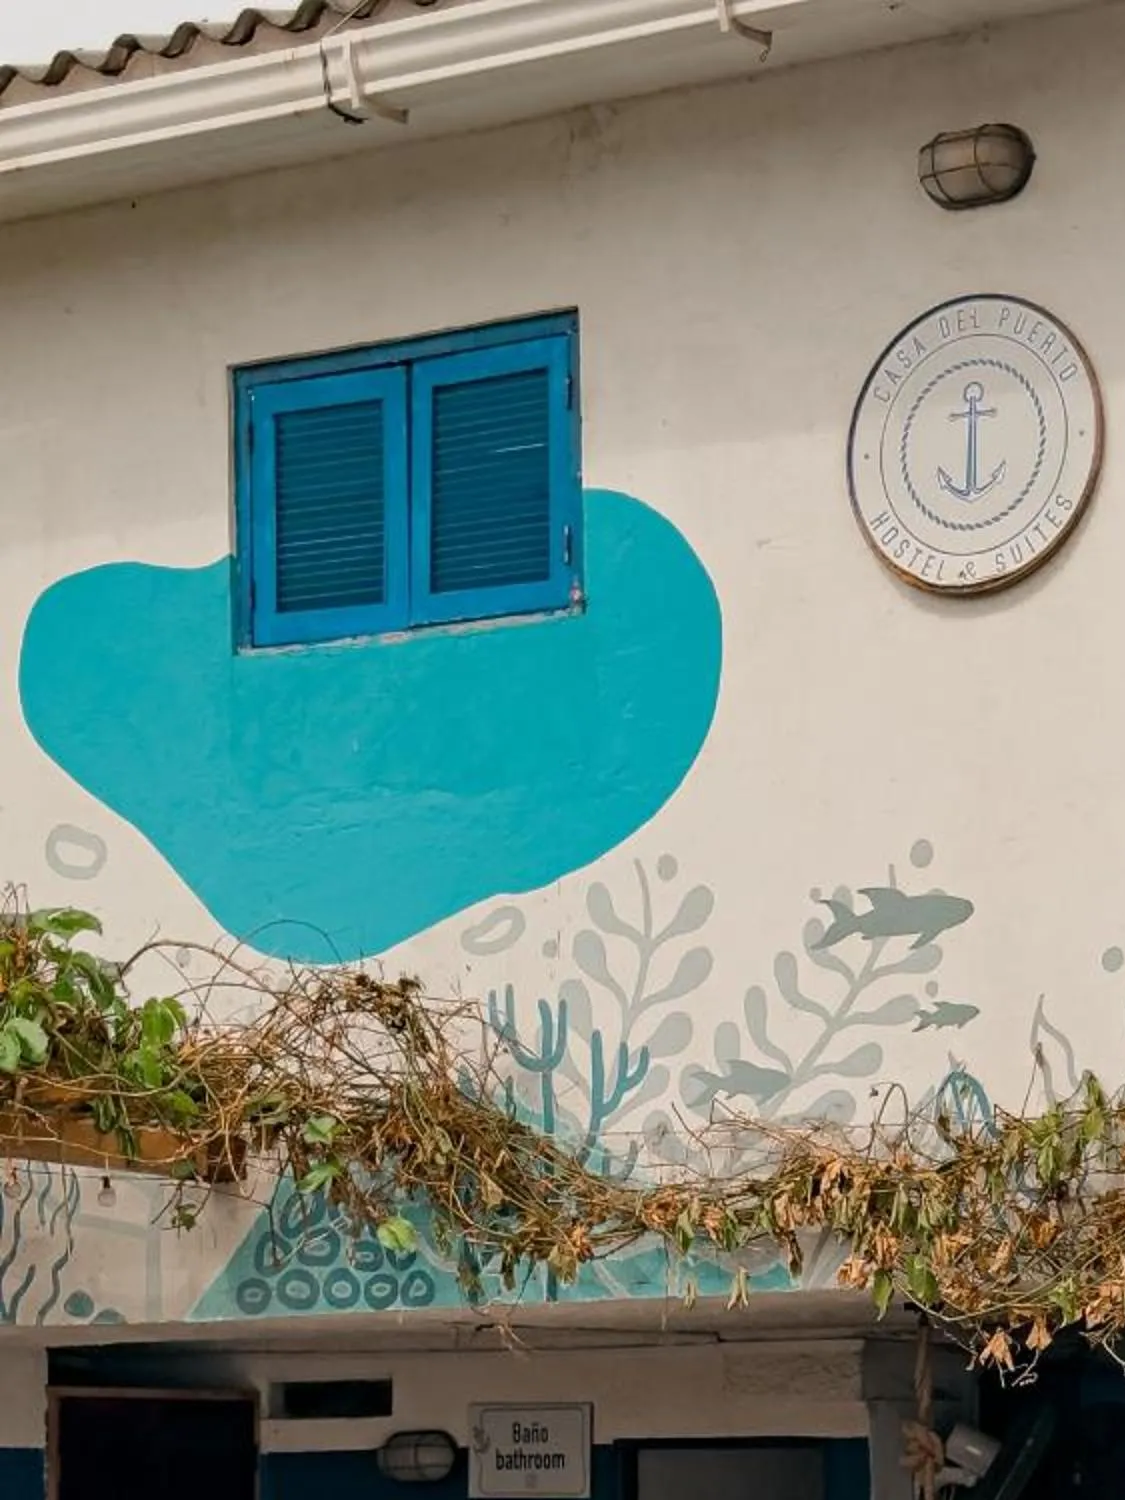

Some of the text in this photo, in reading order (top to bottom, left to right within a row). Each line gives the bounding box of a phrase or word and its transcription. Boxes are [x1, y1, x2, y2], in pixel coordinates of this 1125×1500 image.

[874, 306, 1078, 403] CASA DEL PUERTO
[870, 510, 945, 582] HOSTEL
[995, 493, 1074, 573] SUITES
[495, 1447, 566, 1471] bathroom
[512, 1421, 549, 1443] Baño
